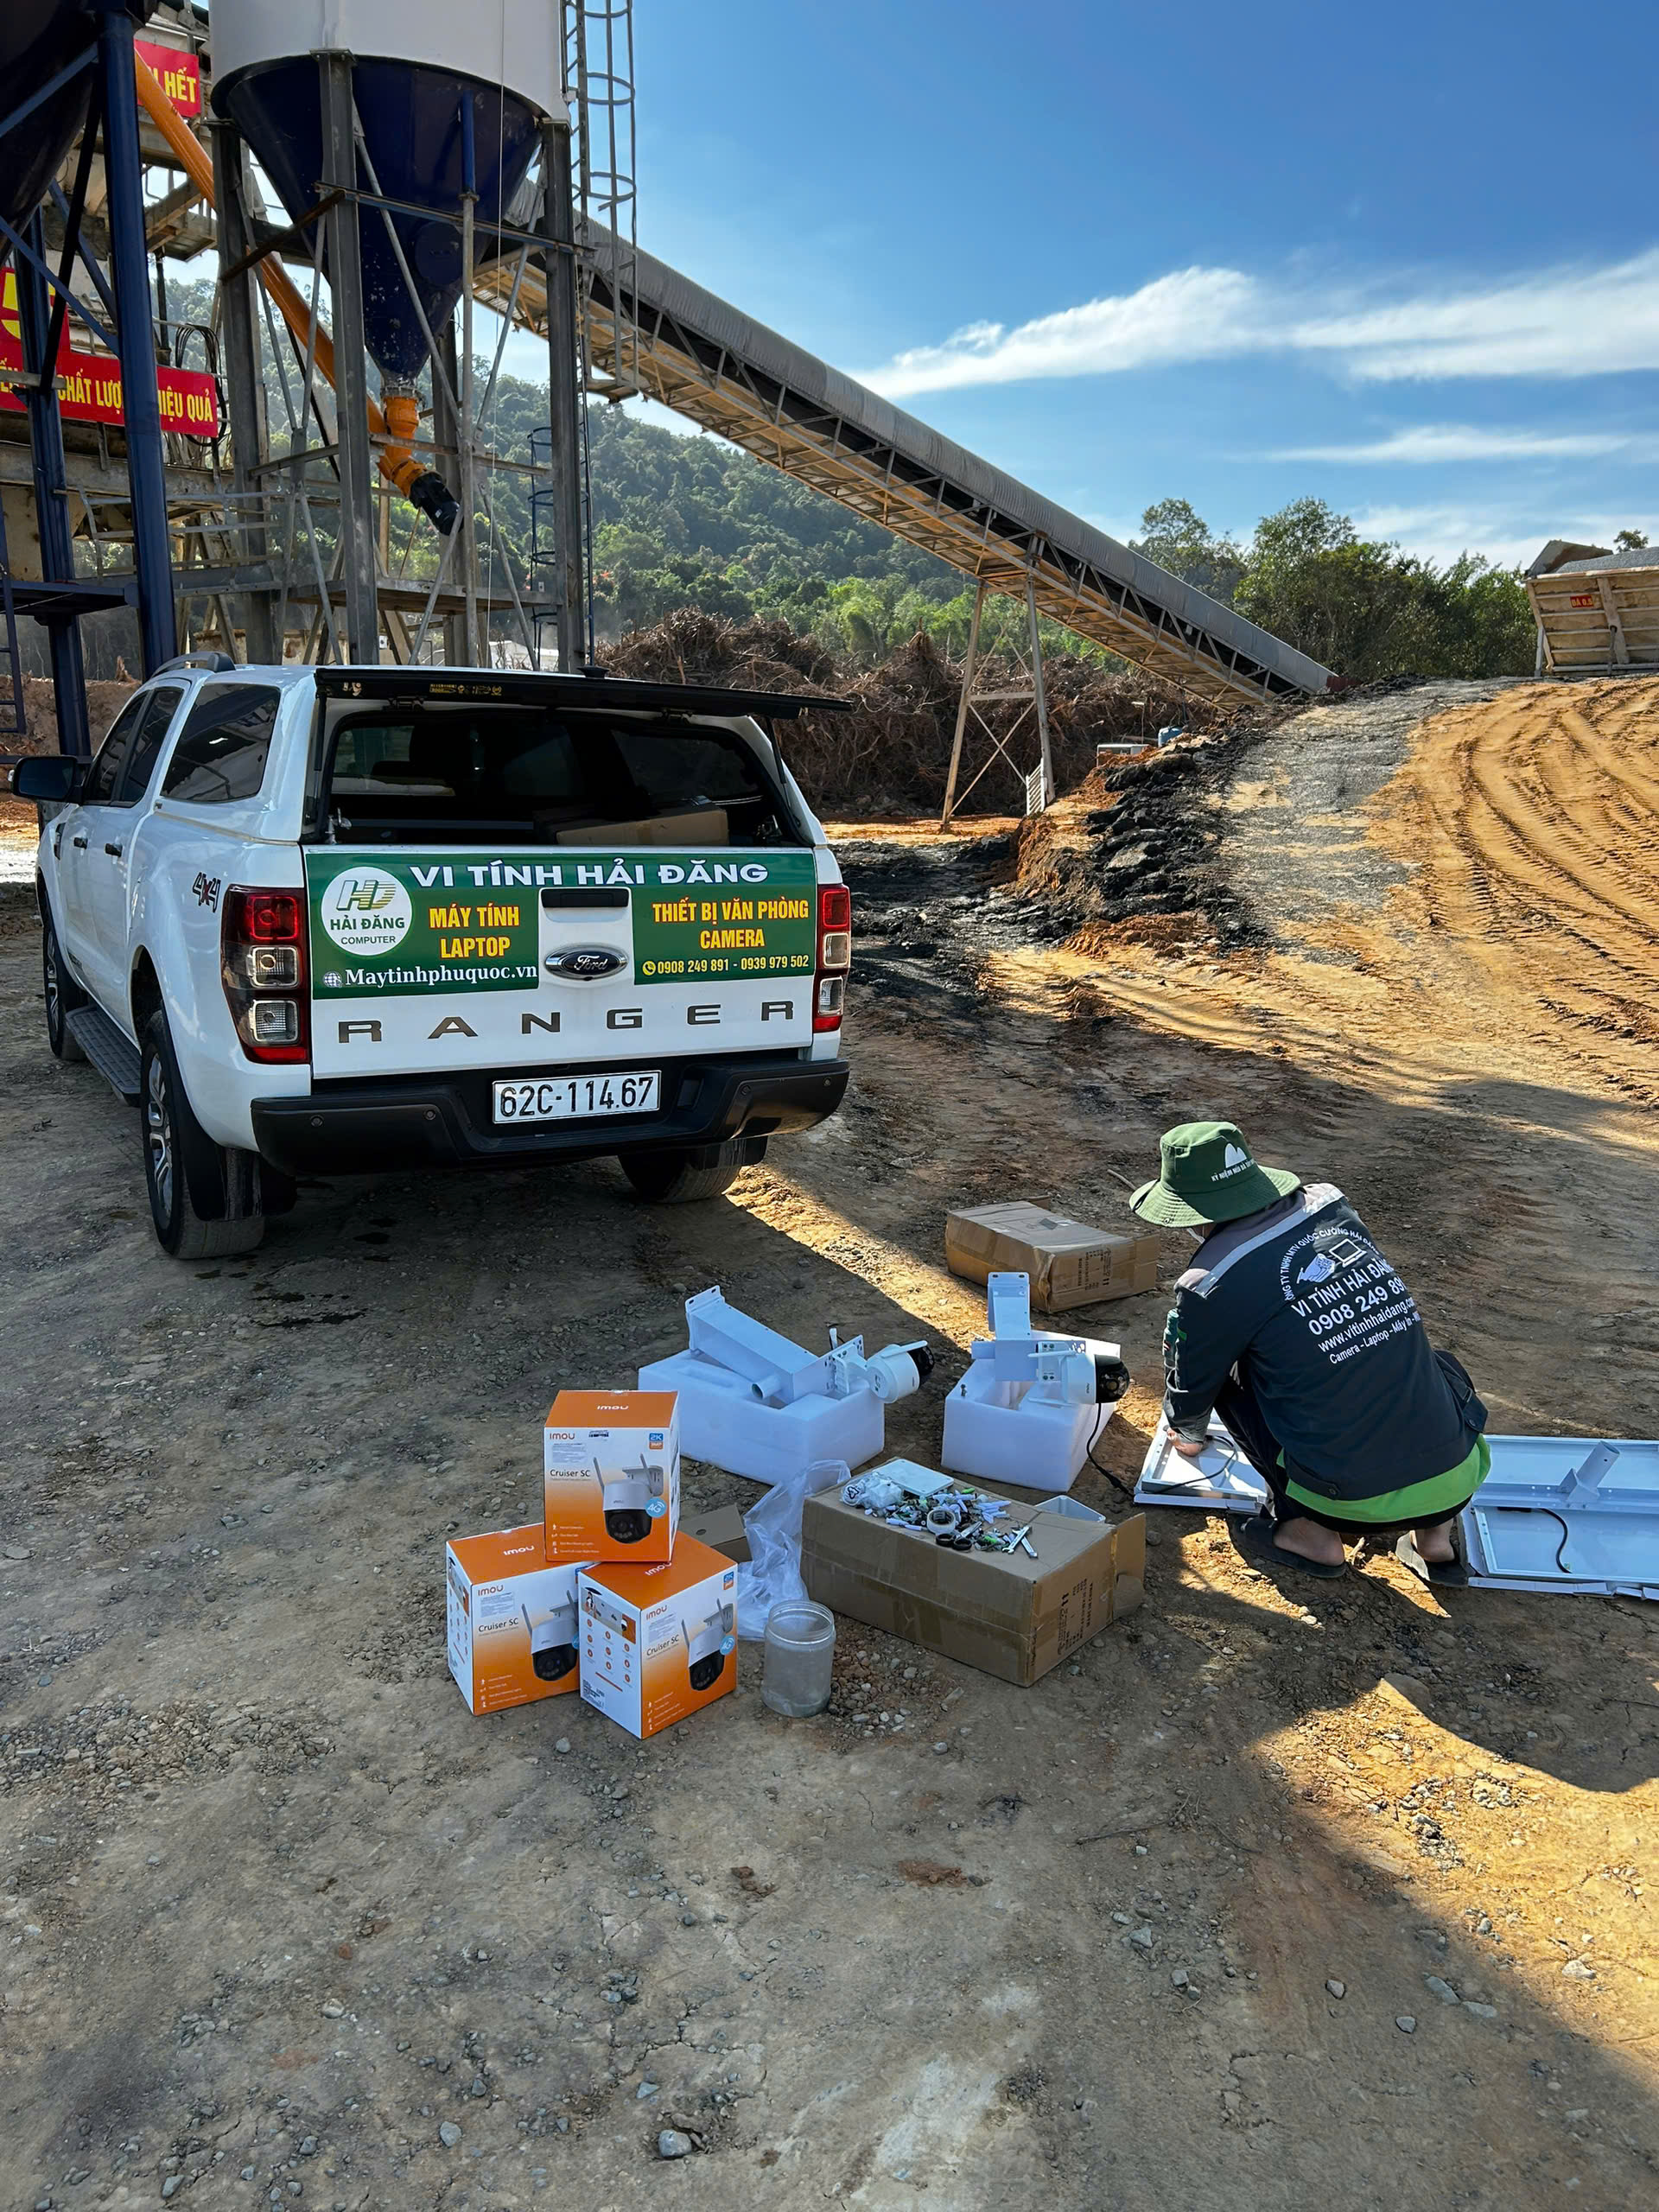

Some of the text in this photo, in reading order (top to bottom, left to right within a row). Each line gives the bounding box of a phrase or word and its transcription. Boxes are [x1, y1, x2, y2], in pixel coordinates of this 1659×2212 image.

[163, 67, 196, 103] HẾT
[95, 378, 123, 415] LƯỢ
[187, 388, 213, 423] QUẢ
[408, 858, 769, 887] VI TÍNH HẢI ĐĂNG
[193, 872, 221, 912] 4x4
[429, 903, 520, 929] MÁY TÍNH
[652, 896, 809, 925] THIẾT BỊ VĂN PHÒNG
[330, 914, 406, 931] HẢI ĐĂNG
[340, 935, 397, 945] COMPUTER
[440, 936, 512, 958] LAPTOP
[700, 928, 766, 949] CAMERA
[574, 954, 608, 971] Ford
[658, 961, 684, 974] 0908
[688, 959, 708, 973] 249
[710, 958, 729, 971] 891
[741, 957, 766, 970] 0939
[769, 956, 788, 969] 979
[791, 955, 809, 968] 502
[345, 964, 538, 988] Maytinhphuquoc.vn
[338, 1001, 794, 1043] RANGER
[499, 1076, 654, 1118] 62C-114.67
[1286, 1244, 1300, 1256] MTV
[1280, 1274, 1290, 1285] TY
[1282, 1285, 1295, 1301] ÔNG
[1291, 1300, 1313, 1317] VI
[1308, 1281, 1347, 1308] TÍNH
[1343, 1268, 1371, 1292] HẢI
[1308, 1303, 1355, 1335] 0908
[1355, 1286, 1389, 1313] 249
[1330, 1344, 1361, 1364] Camera
[1363, 1330, 1390, 1348] Laptop
[550, 1432, 575, 1440] imou
[550, 1469, 591, 1478] Cruiser SC
[648, 1503, 662, 1513] 4G
[503, 1545, 535, 1555] imou
[477, 1584, 504, 1597] imou
[645, 1604, 668, 1621] imou
[478, 1619, 507, 1633] Cruiser
[646, 1640, 670, 1656] Cruiser
[671, 1634, 680, 1643] SC
